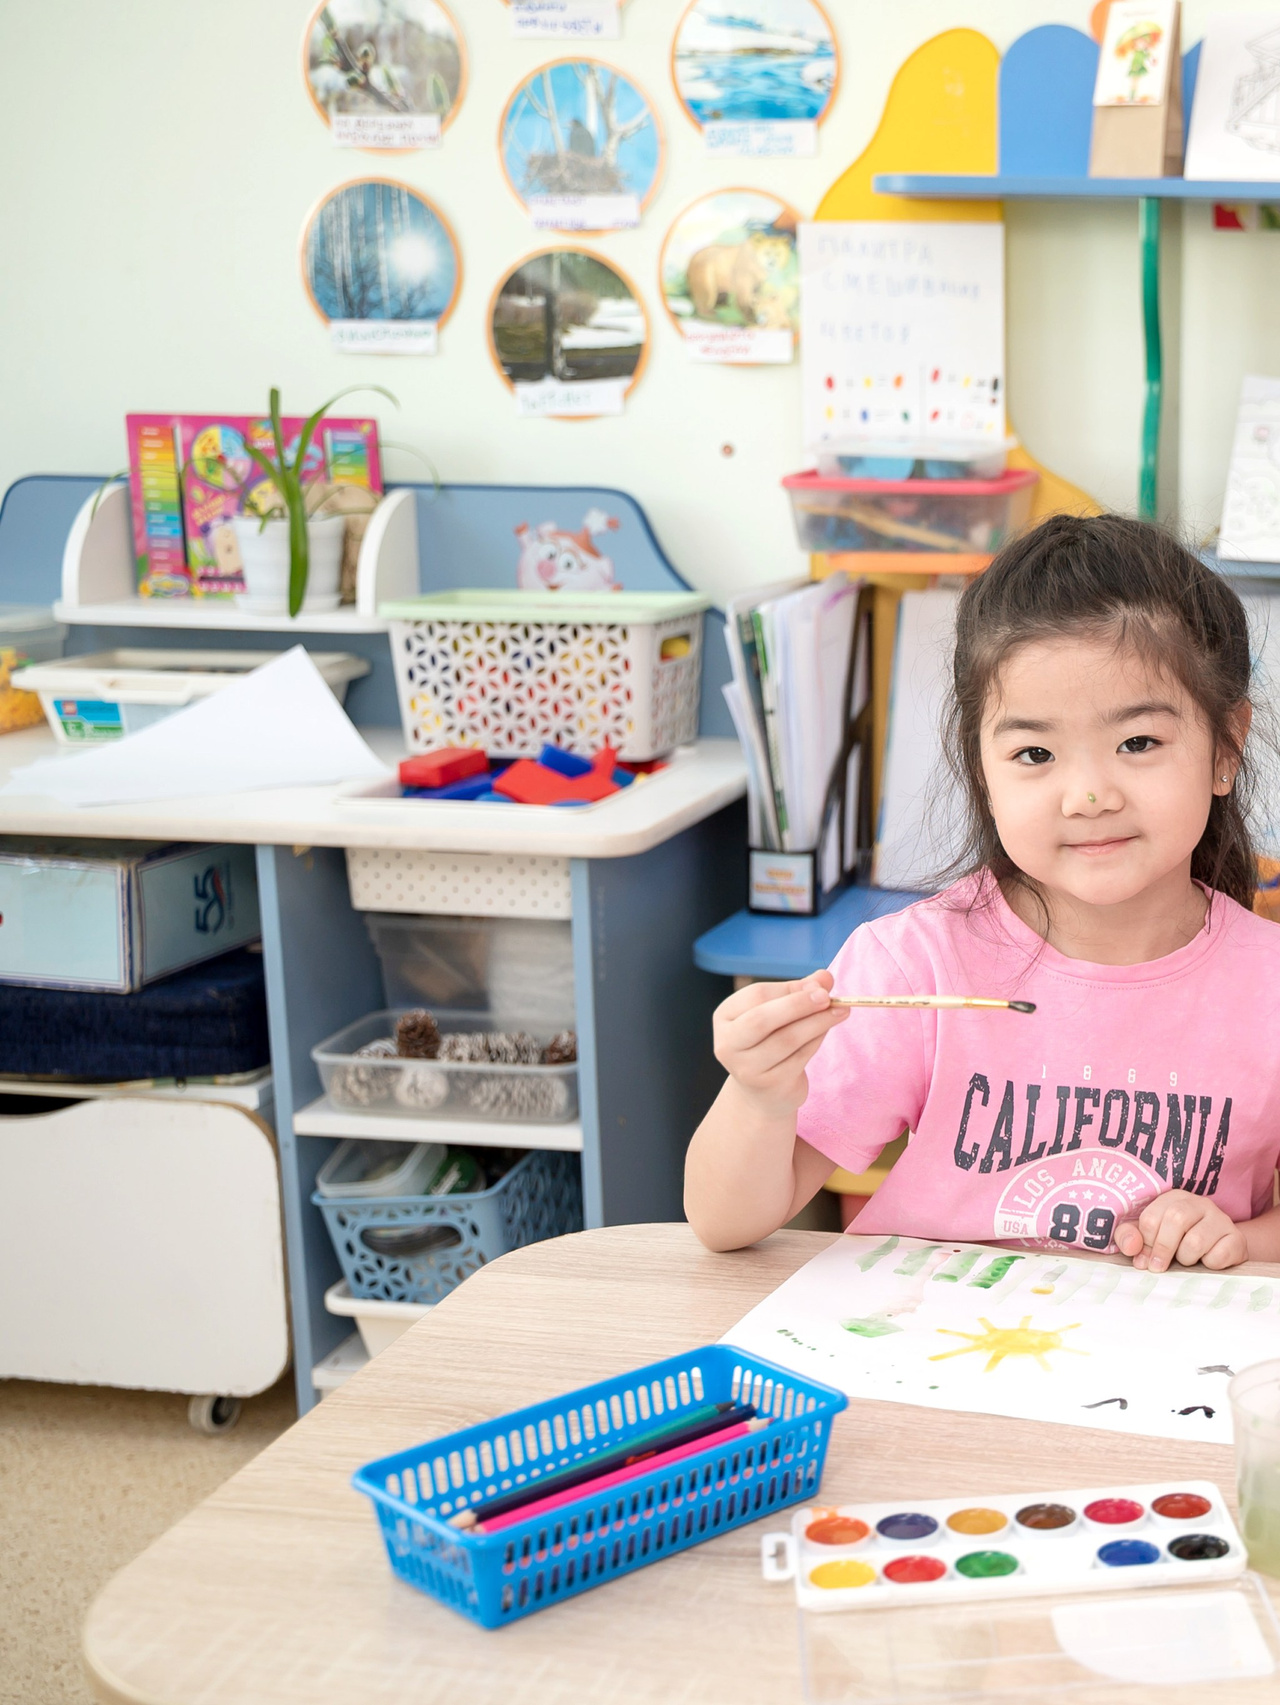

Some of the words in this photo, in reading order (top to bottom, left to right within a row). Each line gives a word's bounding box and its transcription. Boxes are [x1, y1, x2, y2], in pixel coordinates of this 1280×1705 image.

[953, 1072, 1233, 1196] CALIFORNIA
[1013, 1169, 1055, 1209] LOS
[1072, 1157, 1151, 1209] ANGEL
[1002, 1219, 1029, 1236] USA
[1048, 1203, 1116, 1250] 89
